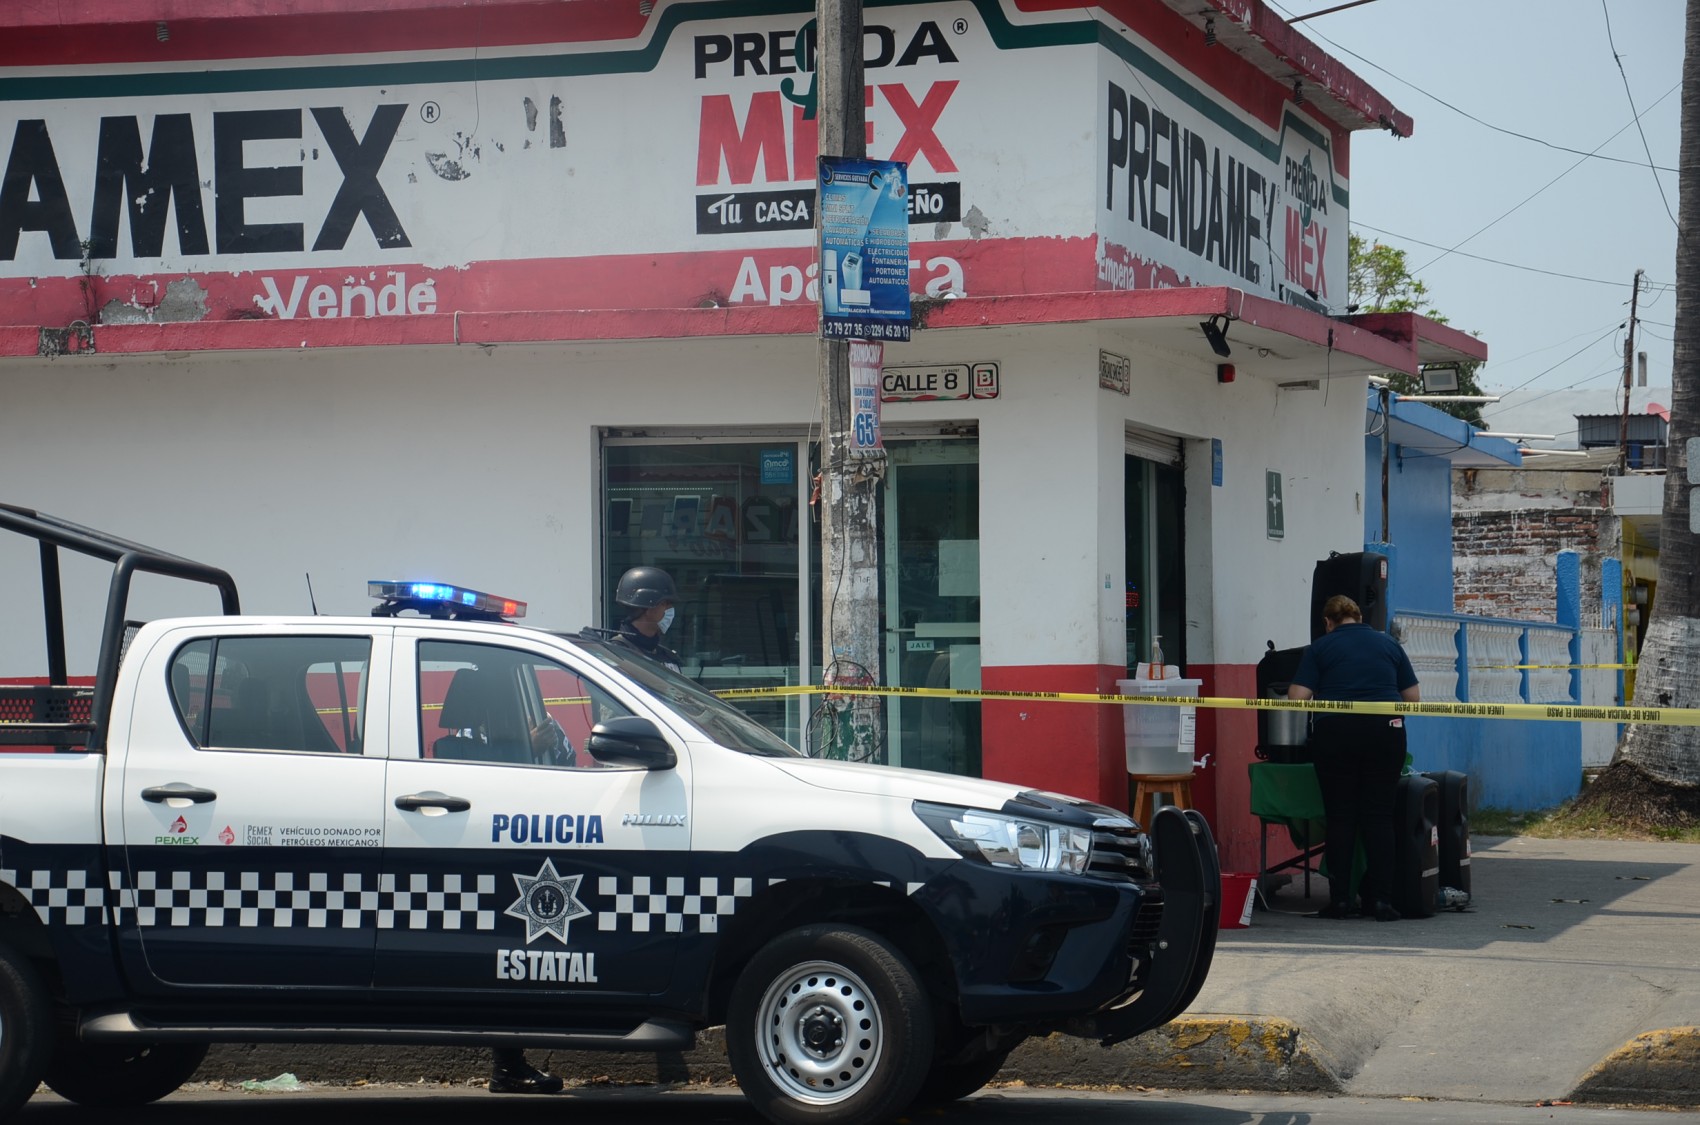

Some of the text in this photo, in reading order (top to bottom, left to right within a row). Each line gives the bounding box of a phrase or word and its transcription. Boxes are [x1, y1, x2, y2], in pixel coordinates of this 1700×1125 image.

[694, 20, 959, 80] PREDA
[755, 200, 809, 223] CASA
[1285, 205, 1328, 299] MEX
[876, 267, 906, 276] PORTONES
[261, 272, 437, 319] Vende
[828, 322, 833, 334] 2
[834, 322, 843, 335] 79
[844, 323, 852, 335] 27
[854, 323, 862, 336] 35
[882, 374, 937, 392] CALLE
[944, 373, 958, 390] 8
[855, 412, 876, 447] 65
[1394, 703, 1410, 712] PASO
[1420, 704, 1452, 713] PROHIBIDO
[1454, 704, 1476, 714] POLICIA
[1478, 705, 1486, 715] DE
[1488, 705, 1504, 716] LINEA
[1547, 708, 1660, 721] LINEA DE POLICIA PROHIBIDO EL PASO
[622, 812, 687, 827] HILUX
[247, 825, 273, 836] PEMEX
[280, 826, 381, 836] VEHÍCULO DONADO POR
[491, 813, 604, 844] POLICIA
[155, 836, 199, 845] PEMEX
[247, 836, 273, 845] SOCIAL
[281, 837, 379, 847] PETRÓLEOS MEXICANOS
[496, 949, 598, 983] ESTATAL
